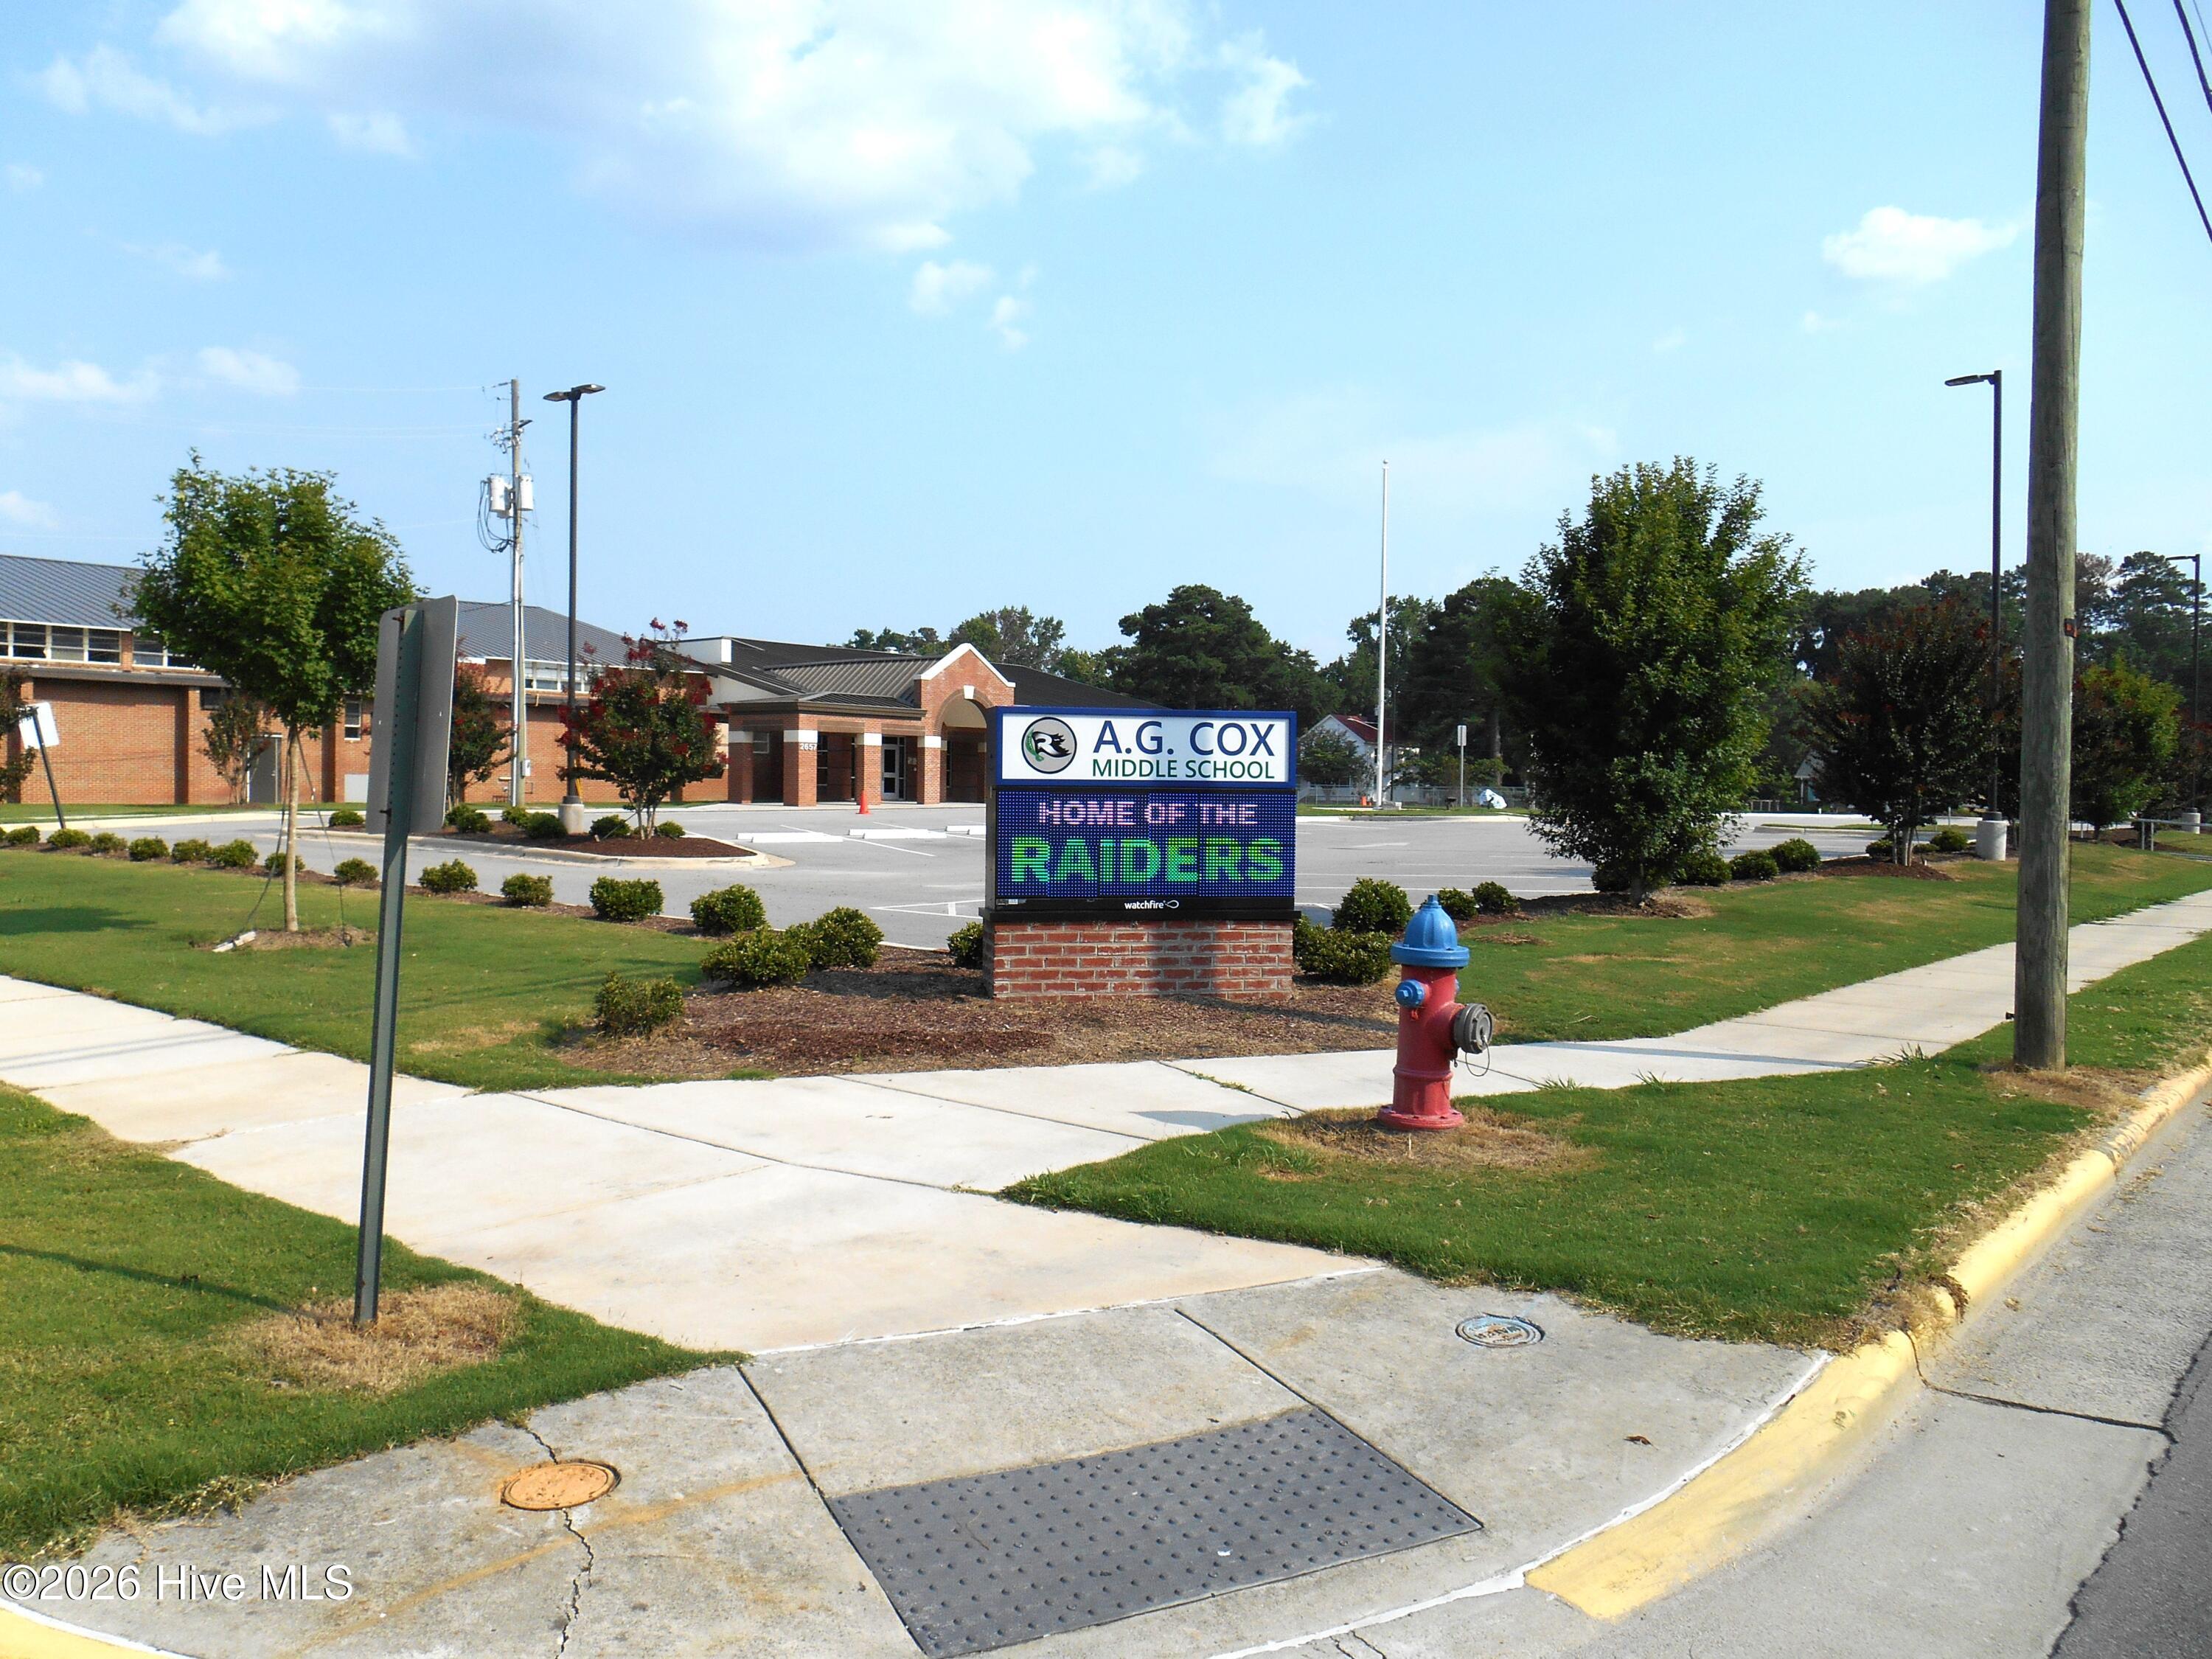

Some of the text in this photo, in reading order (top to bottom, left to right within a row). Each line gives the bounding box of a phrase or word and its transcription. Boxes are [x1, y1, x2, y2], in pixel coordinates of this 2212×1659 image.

[799, 742, 818, 751] 2657
[1093, 720, 1275, 757] A.G. COX
[1092, 759, 1275, 779] MIDDLE SCHOOL
[1039, 801, 1258, 825] HOME OF THE
[1011, 836, 1284, 883] RAIDERS
